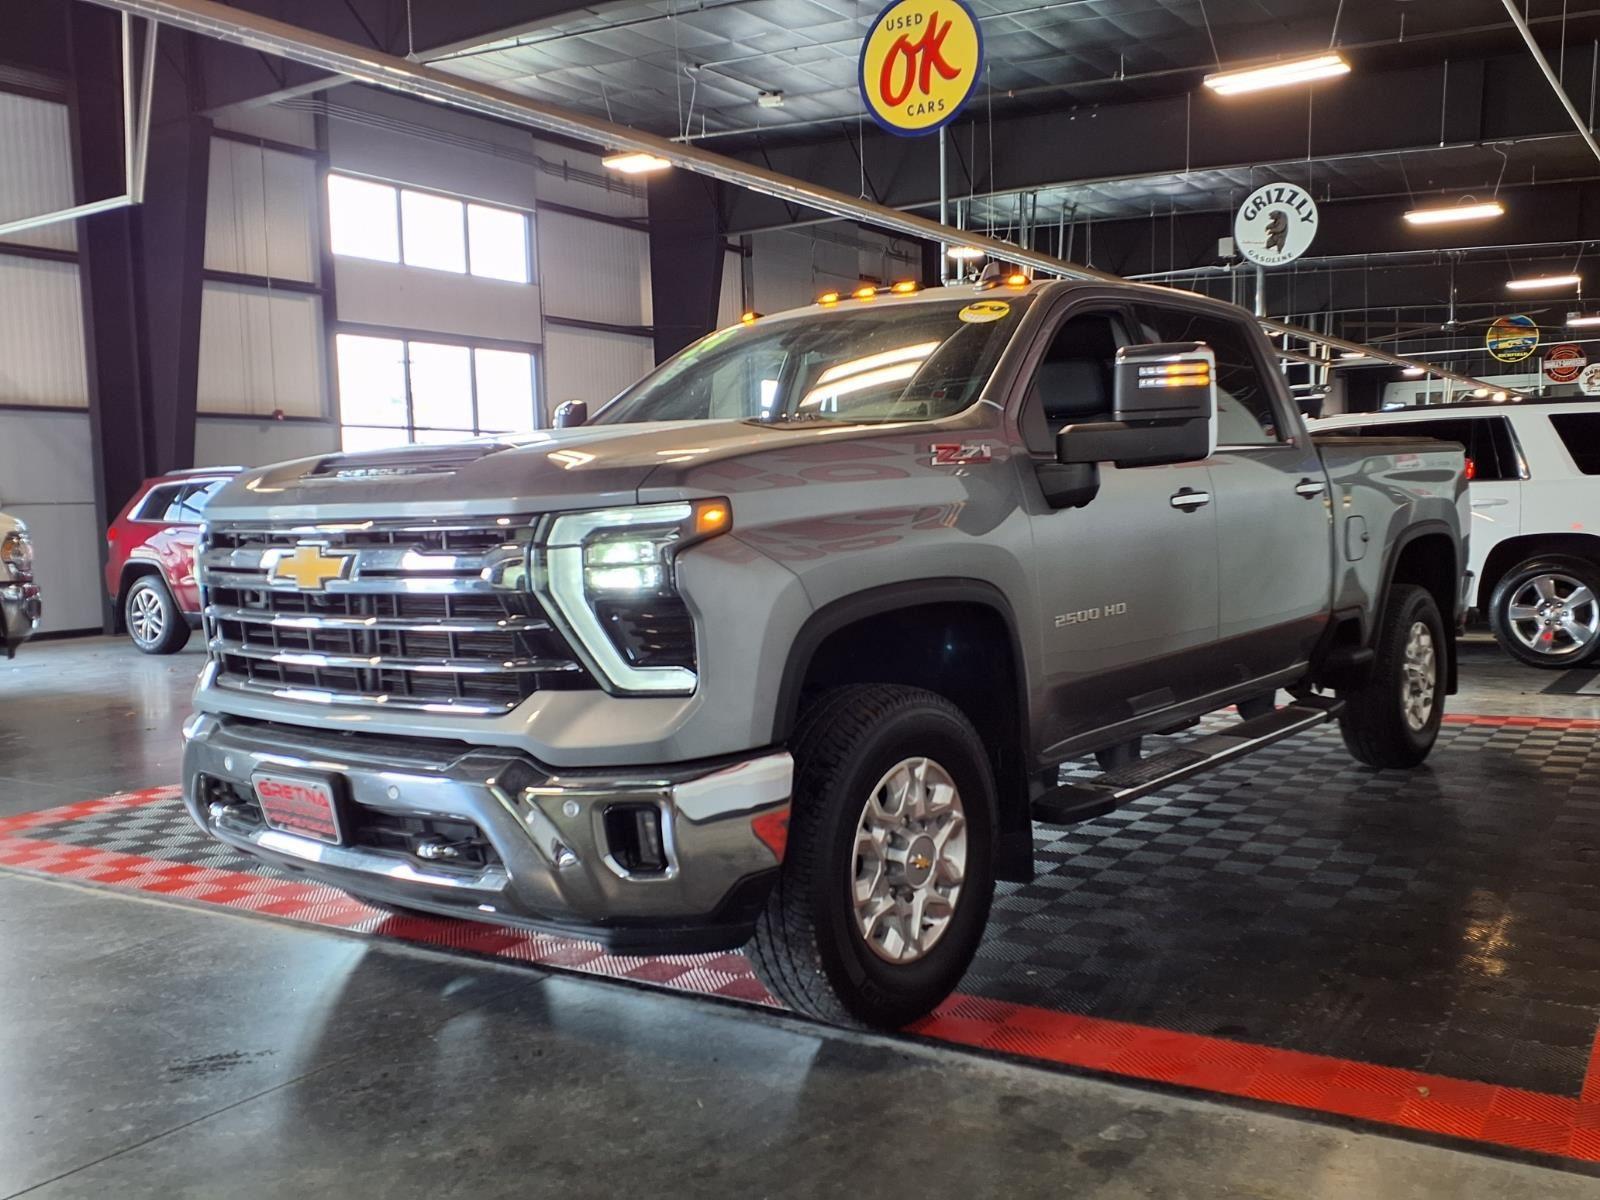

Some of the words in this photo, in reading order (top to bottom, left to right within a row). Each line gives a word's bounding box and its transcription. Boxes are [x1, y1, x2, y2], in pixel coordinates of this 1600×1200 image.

[886, 13, 923, 31] USED
[880, 10, 962, 107] OK
[907, 98, 945, 117] CARS
[1243, 187, 1314, 224] GRIZZLY
[1247, 249, 1293, 263] GASOLINE
[931, 443, 992, 466] Z71
[1055, 608, 1100, 628] 2500
[1104, 602, 1126, 617] HD
[258, 780, 330, 808] GRETNA
